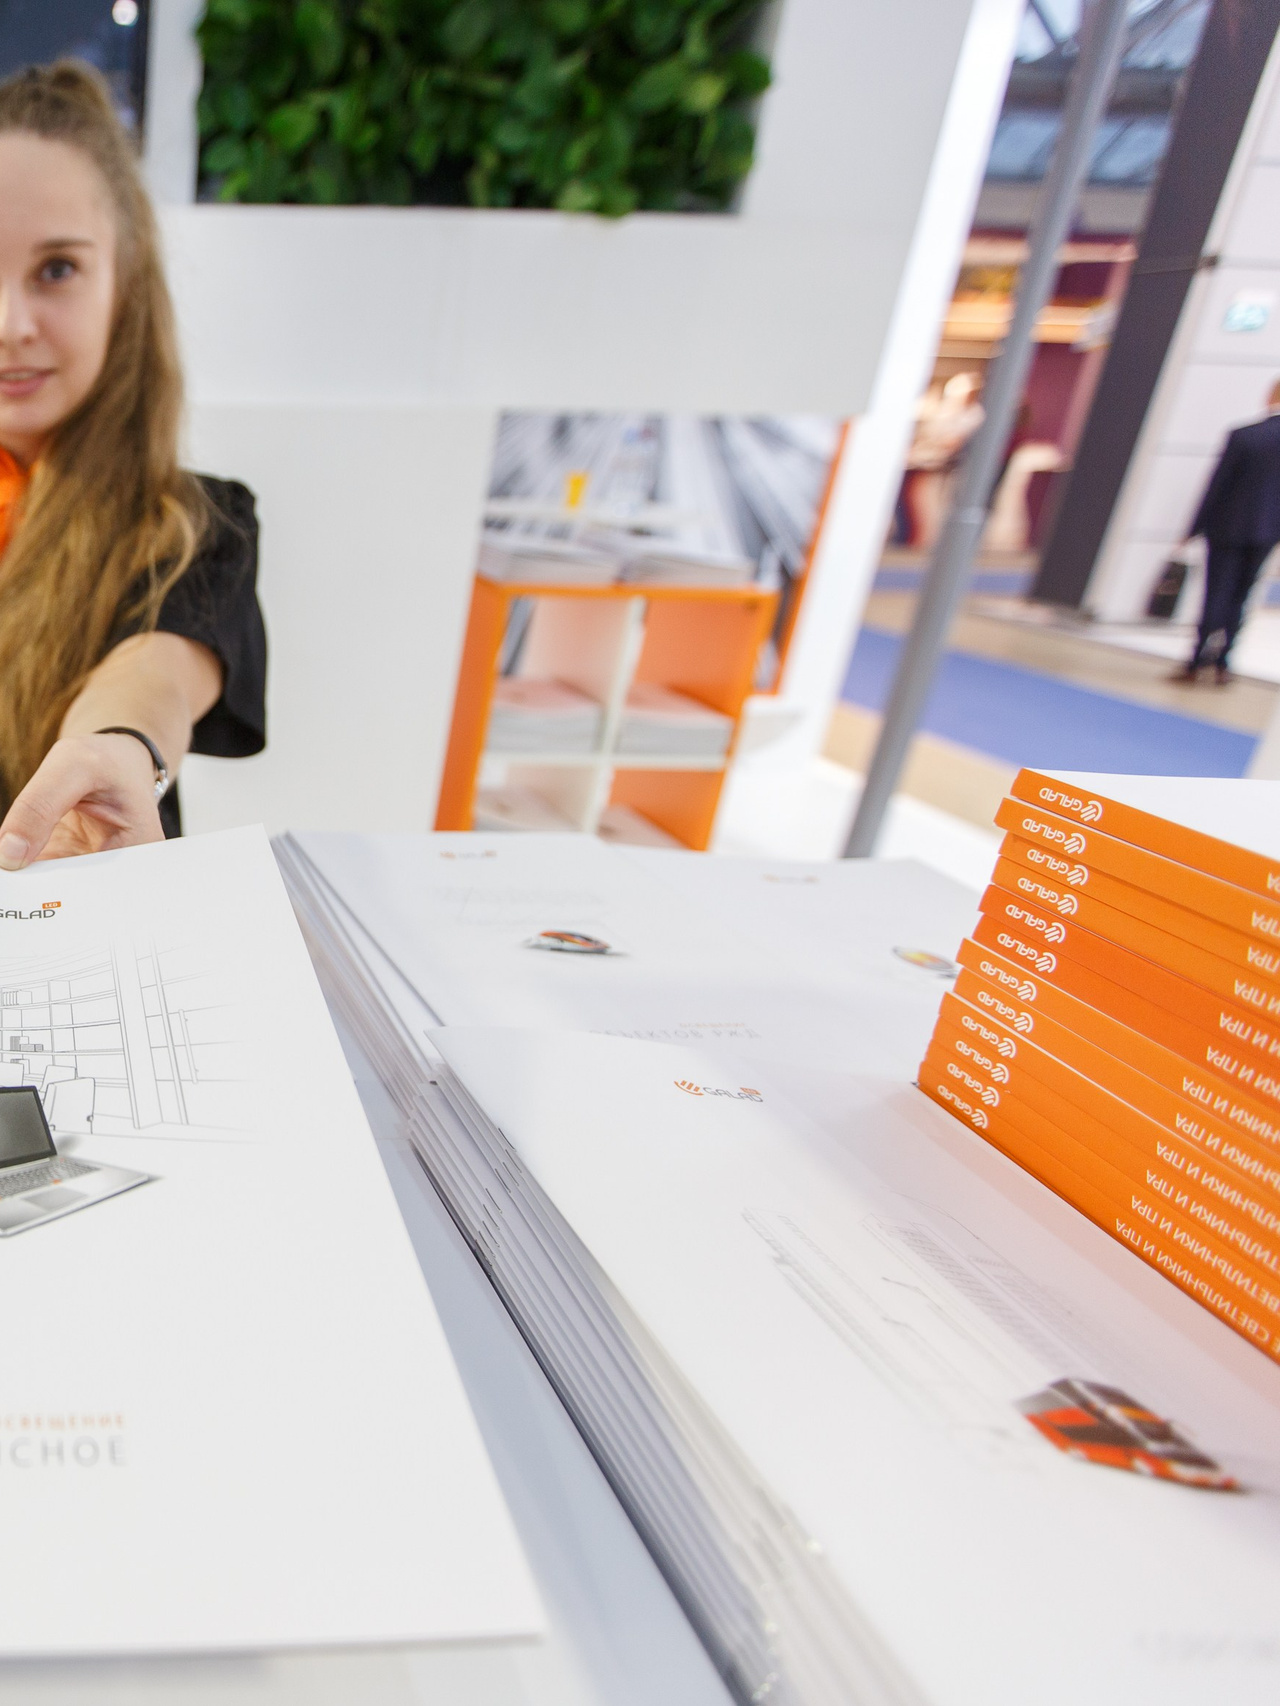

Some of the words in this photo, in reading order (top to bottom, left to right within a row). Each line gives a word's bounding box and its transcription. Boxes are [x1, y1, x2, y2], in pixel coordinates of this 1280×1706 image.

[1039, 787, 1083, 812] GALAD
[1022, 818, 1066, 843] GALAD
[1027, 848, 1069, 875] GALAD
[1017, 877, 1059, 904] GALAD
[1005, 904, 1047, 931] GALAD
[997, 933, 1038, 961] GALAD
[979, 960, 1019, 989] GALAD
[977, 991, 1016, 1020] GALAD
[1234, 979, 1267, 1007] ПРА
[961, 1015, 1000, 1045] GALAD
[1219, 1012, 1252, 1040] ПРА
[1252, 1029, 1269, 1049] И
[955, 1040, 993, 1070] GALAD
[1206, 1045, 1239, 1075] ПРА
[946, 1062, 984, 1094] GALAD
[1238, 1064, 1255, 1083] И
[702, 1087, 763, 1102] GALAD
[937, 1085, 972, 1115] GALAD
[1182, 1076, 1213, 1105] ПРА
[1213, 1096, 1229, 1114] И
[1175, 1112, 1206, 1142] ПРА
[1156, 1141, 1185, 1170] ПРА
[1205, 1133, 1221, 1151] И
[1145, 1169, 1174, 1198] ПРА
[1186, 1162, 1201, 1180] И
[1131, 1195, 1158, 1224] ПРА
[1175, 1191, 1189, 1208] И
[1115, 1218, 1142, 1247] ПРА
[1159, 1217, 1173, 1234] И
[1143, 1240, 1155, 1257] И
[1156, 1250, 1270, 1343] СВЕТИЛЬНИКИ
